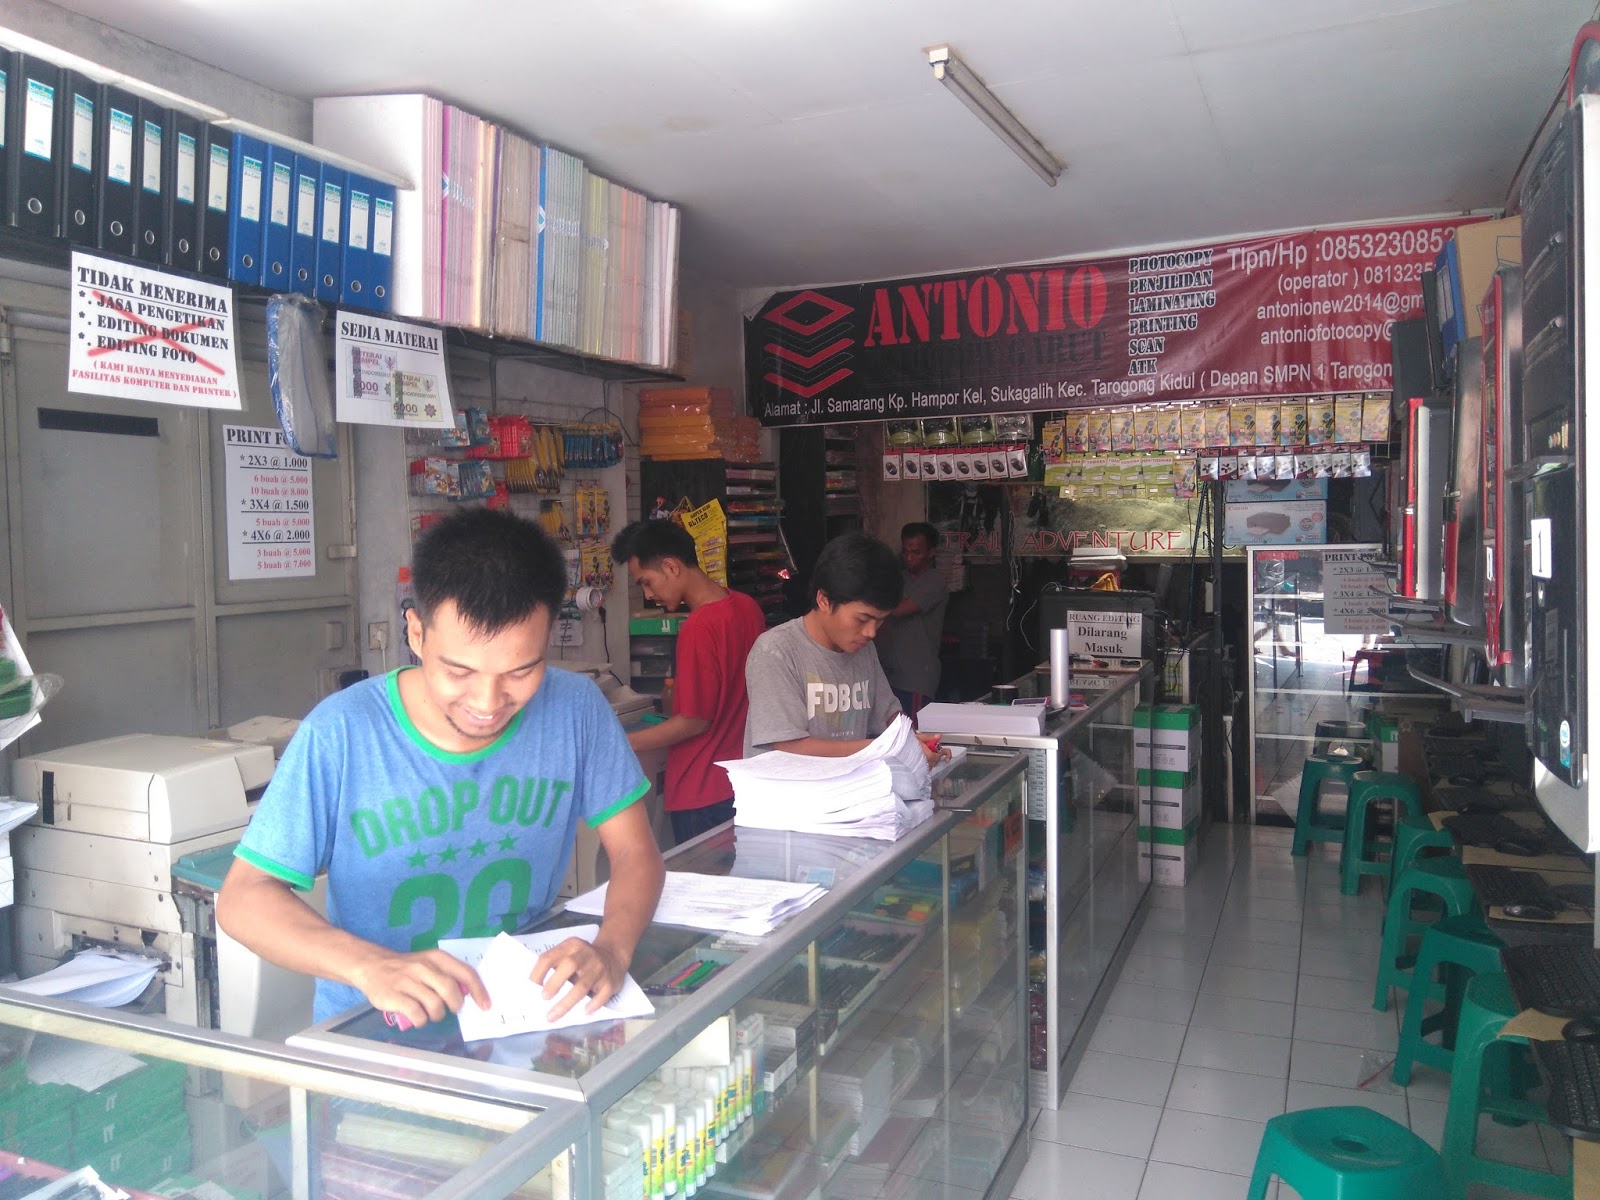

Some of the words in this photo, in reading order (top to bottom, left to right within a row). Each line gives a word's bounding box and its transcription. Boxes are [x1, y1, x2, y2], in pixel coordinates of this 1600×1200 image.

[1129, 250, 1213, 272] PHOTOCOPY
[1226, 240, 1307, 274] Tlpn/Hp
[77, 266, 134, 293] TIDAK
[140, 281, 228, 313] MENERIMA
[1128, 270, 1213, 293] PENJILIDAN
[1278, 273, 1348, 295] (operator
[97, 295, 133, 313] JASA
[138, 302, 225, 331] PENGETIKAN
[864, 265, 1108, 347] ANTONIO
[1128, 290, 1217, 315] LAMINATING
[97, 314, 157, 337] EDITING
[162, 327, 229, 350] DOKUMEN
[1128, 313, 1198, 335] PRINTING
[341, 321, 381, 341] SEDIA
[384, 329, 439, 351] MATERAI
[1128, 336, 1165, 356] SCAN
[97, 335, 158, 357] EDITING
[162, 346, 197, 363] FOTO
[100, 361, 124, 372] KAMI
[127, 365, 155, 376] HANYA
[158, 370, 218, 385] MENYEDIAKAN
[1128, 356, 1157, 376] ATK
[72, 369, 120, 384] FASILITAS
[123, 376, 170, 390] KOMPUTER
[173, 383, 190, 393] DAN
[193, 386, 231, 397] PRINTER
[764, 401, 801, 417] Alamat
[827, 396, 884, 416] Samarang
[888, 392, 908, 411] Kp.
[911, 390, 959, 411] Hampor
[990, 382, 1053, 405] Sukagalih
[1057, 379, 1087, 398] Kec.
[1160, 370, 1195, 391] Kidul
[1210, 367, 1258, 390] Depan
[1264, 363, 1311, 383] SMPN
[227, 428, 271, 445] PRINT
[248, 456, 268, 467] 2X3
[284, 457, 308, 468] 1.000
[261, 475, 279, 483] buah
[250, 486, 259, 495] 10
[261, 486, 279, 495] buah
[249, 499, 270, 510] 3X4
[286, 500, 309, 510] 1.500
[262, 518, 281, 526] buah
[251, 530, 271, 541] 4X6
[286, 530, 310, 540] 2.000
[1020, 530, 1186, 551] ADVENTURE
[263, 549, 281, 557] buah
[1324, 553, 1358, 561] PRINT
[263, 561, 282, 569] buah
[1069, 613, 1100, 621] RUANG
[1078, 626, 1128, 641] Dilarang
[1084, 642, 1123, 654] Masuk
[807, 680, 871, 721] FDBCK
[349, 779, 480, 859] DROP
[489, 774, 573, 829] OUT
